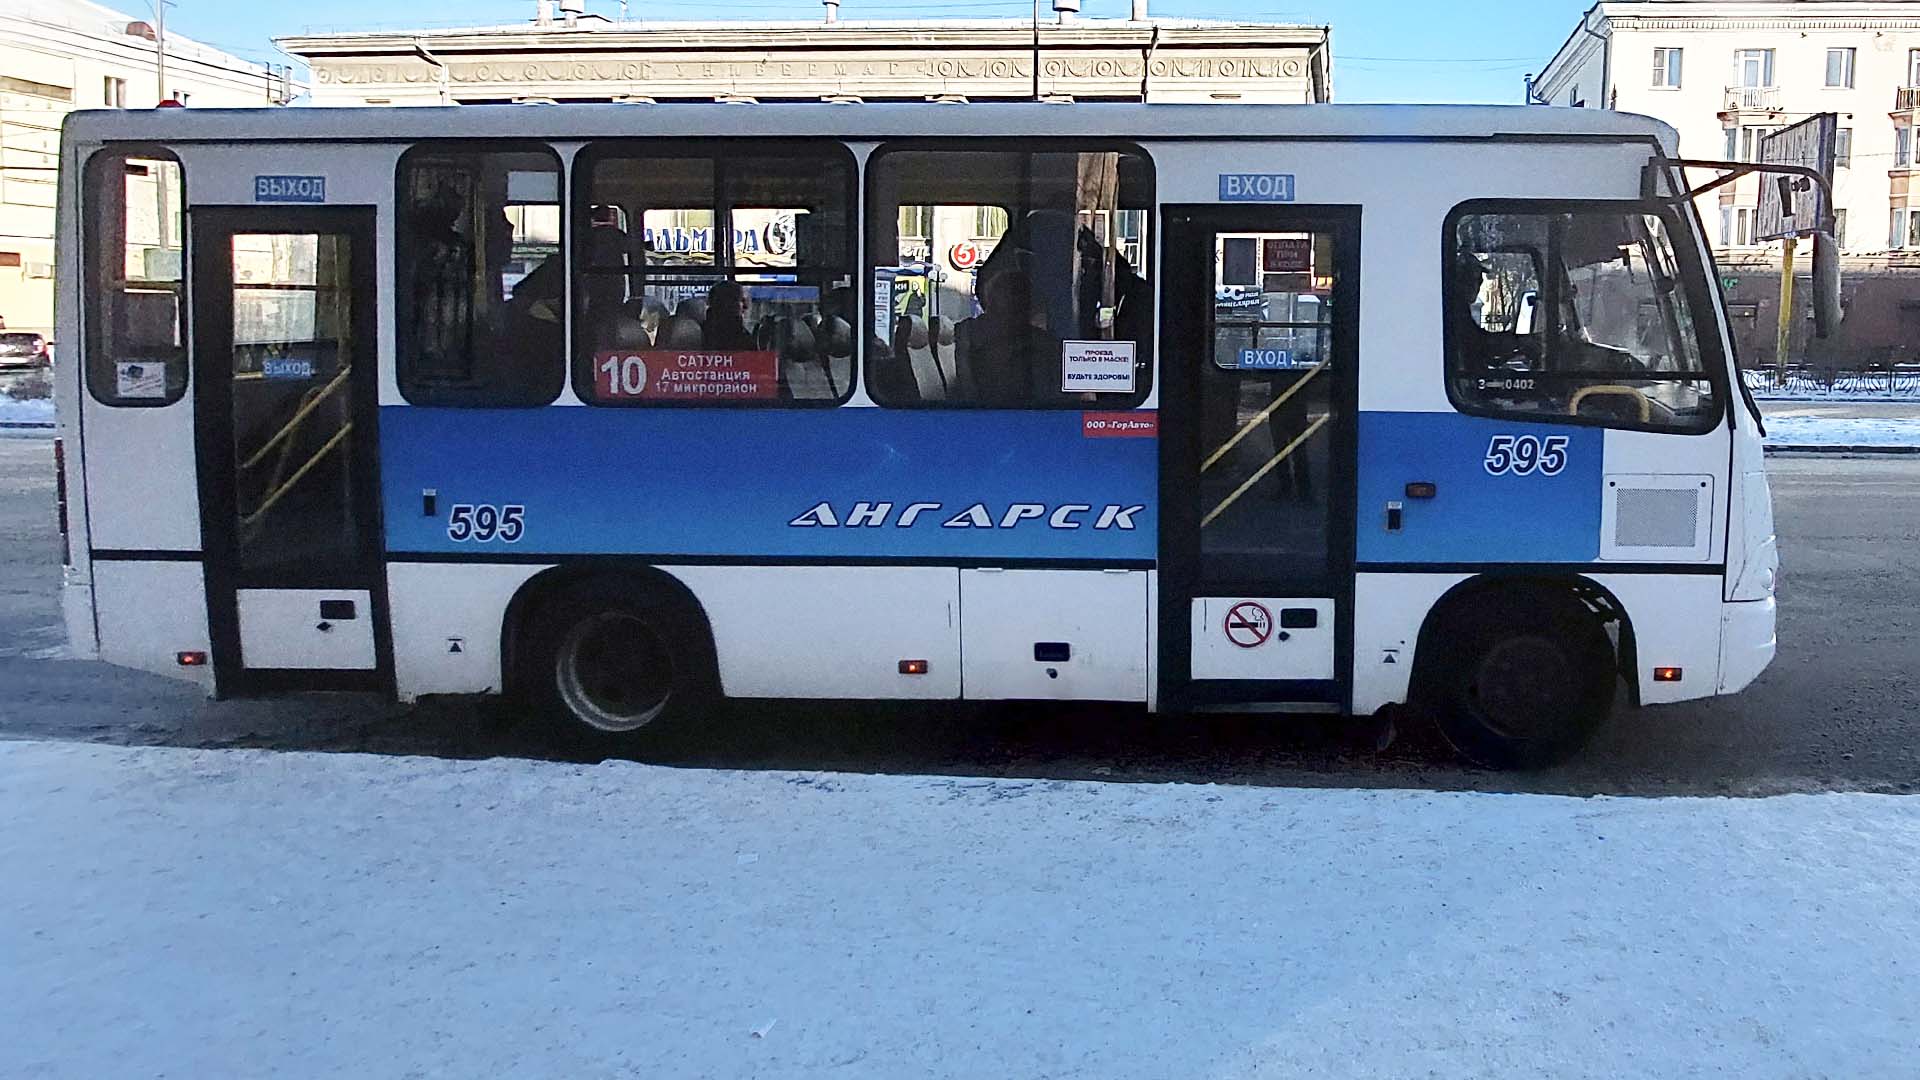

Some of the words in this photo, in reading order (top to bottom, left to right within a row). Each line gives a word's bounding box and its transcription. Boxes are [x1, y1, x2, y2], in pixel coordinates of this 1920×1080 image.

[258, 178, 324, 200] ВЫХОД
[1227, 175, 1288, 200] ВХОД
[677, 354, 733, 368] САТУРН
[1244, 350, 1288, 367] ВХОД
[263, 360, 312, 377] ВЫХОД
[601, 355, 648, 395] 10
[661, 367, 751, 382] Автостанция
[1093, 373, 1130, 381] ЗДОРОВЫ!
[655, 381, 669, 393] 17
[673, 380, 757, 395] микрорайон
[1086, 421, 1106, 429] ООО
[1483, 434, 1570, 476] 595
[447, 503, 526, 543] 595
[788, 501, 1145, 529] АНГАРСК
